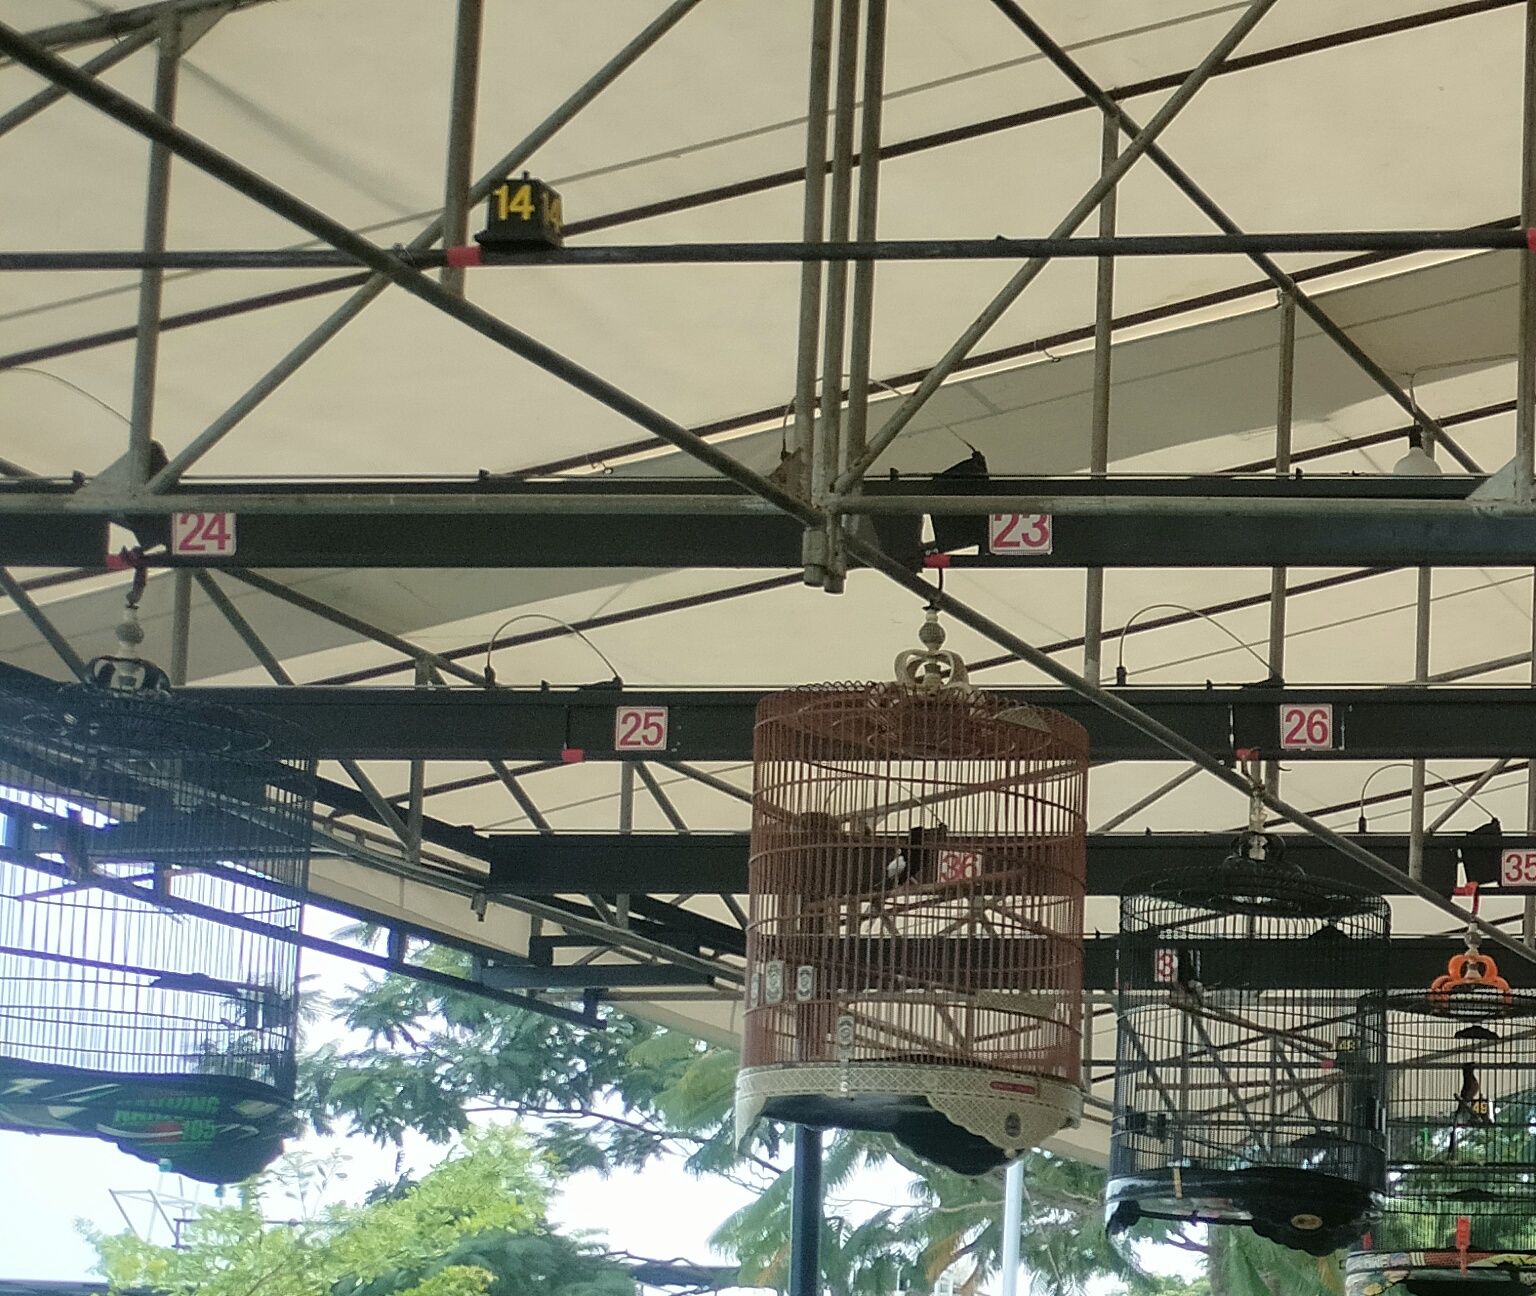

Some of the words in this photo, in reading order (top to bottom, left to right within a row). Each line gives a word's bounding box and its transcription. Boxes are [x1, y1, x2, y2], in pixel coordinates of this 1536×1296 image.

[494, 184, 535, 221] 14
[179, 512, 231, 550] 24
[993, 514, 1050, 549] 23
[619, 711, 664, 746] 25
[1284, 708, 1329, 744] 26
